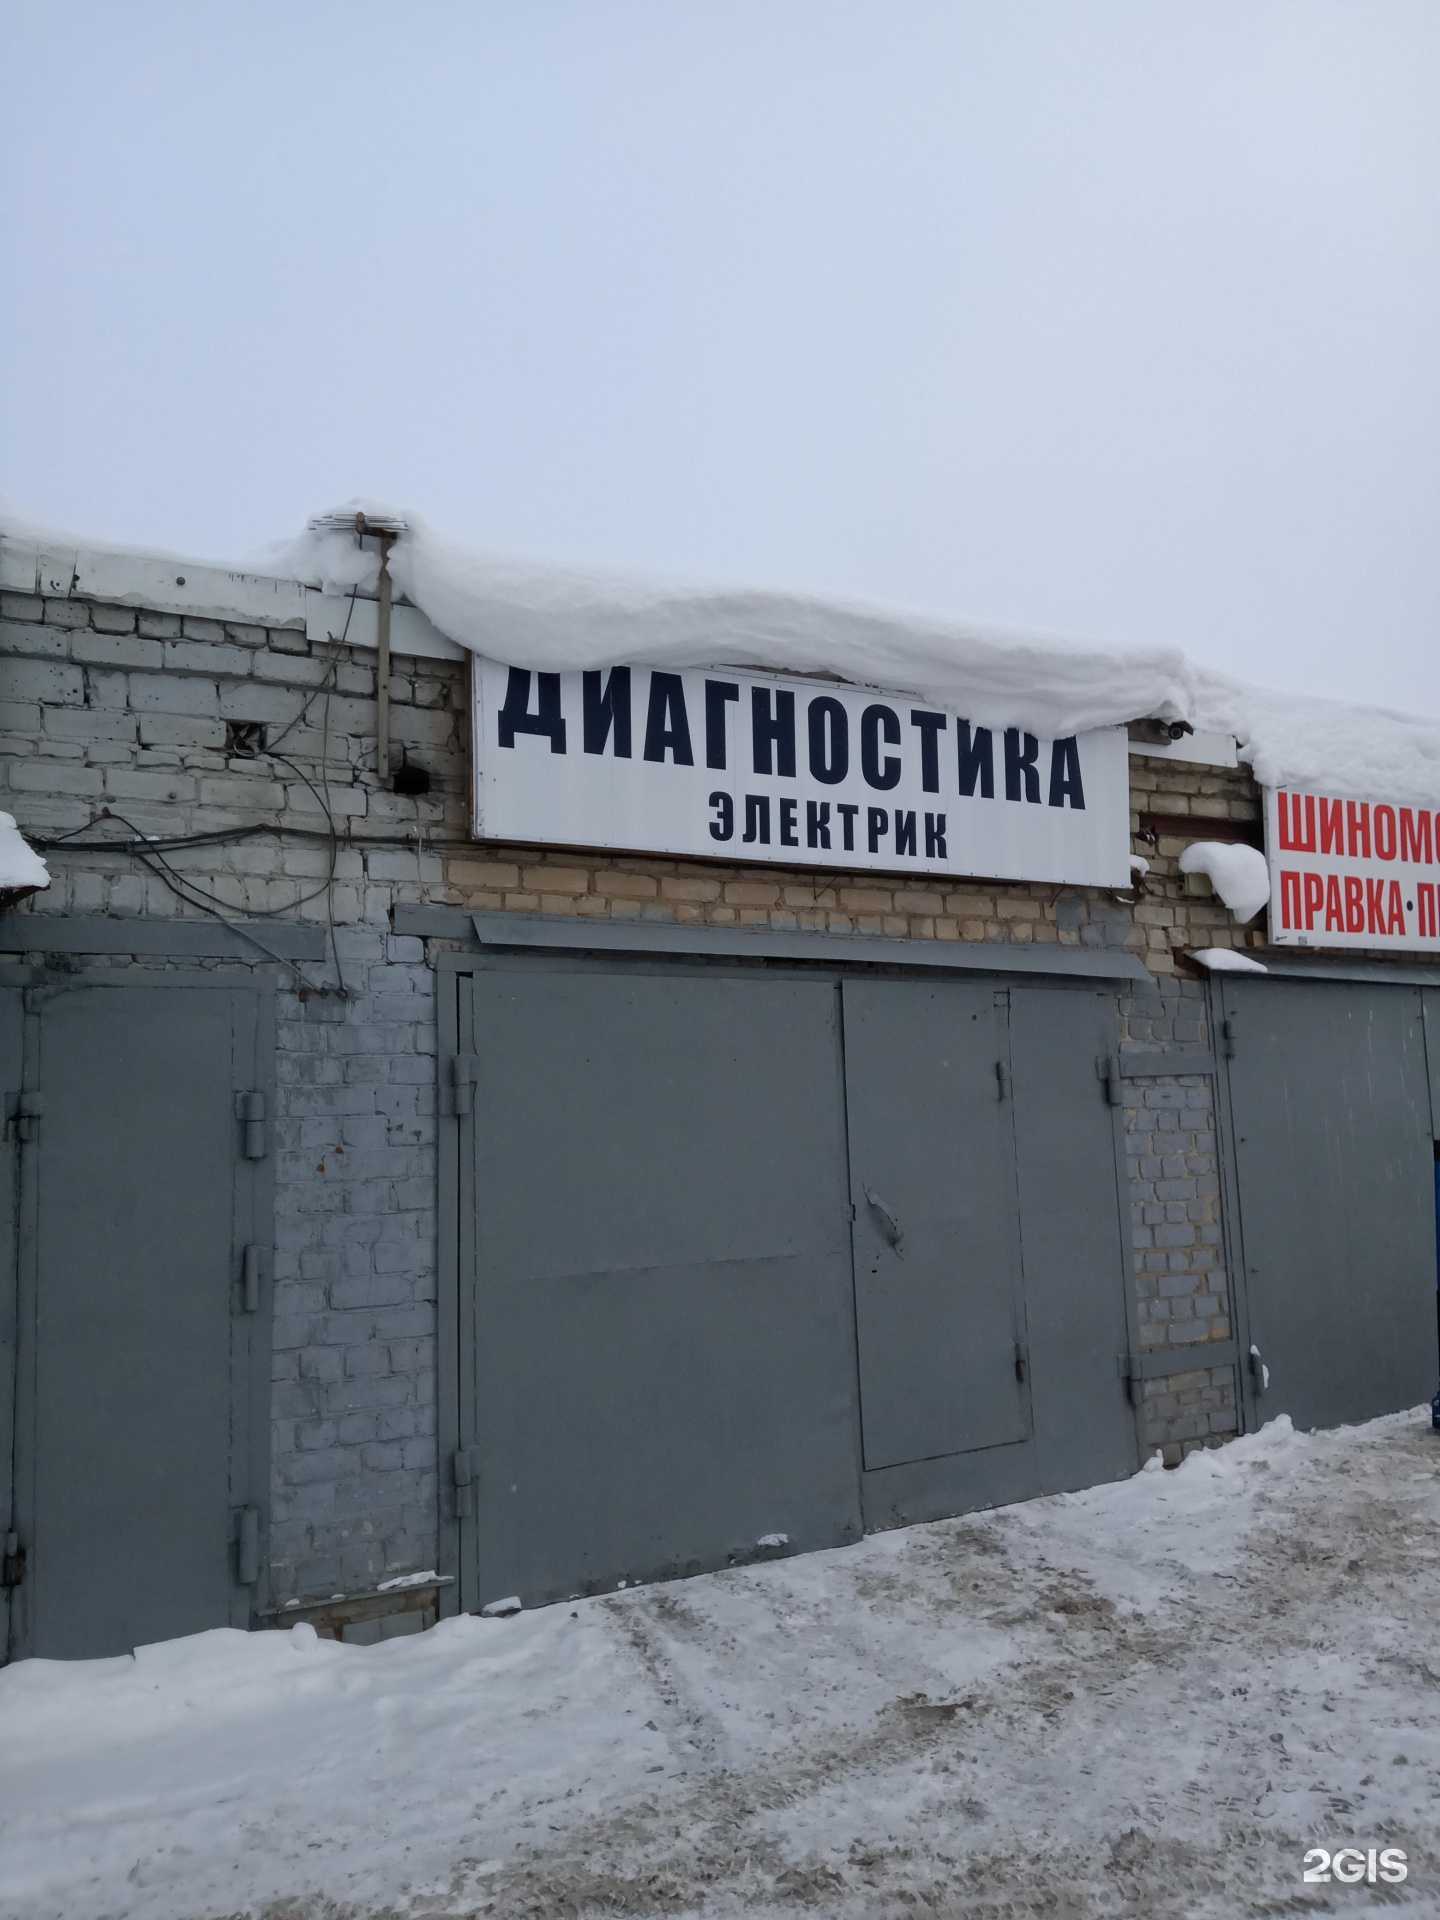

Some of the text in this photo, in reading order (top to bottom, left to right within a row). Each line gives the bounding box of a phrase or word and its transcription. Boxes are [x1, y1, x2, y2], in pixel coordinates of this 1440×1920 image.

[498, 665, 1086, 810] ДИАГНОСТИКА
[708, 790, 948, 859] ЭЛЕКТРИК
[1277, 791, 1440, 864] ШИНОМ
[1417, 882, 1440, 938] П
